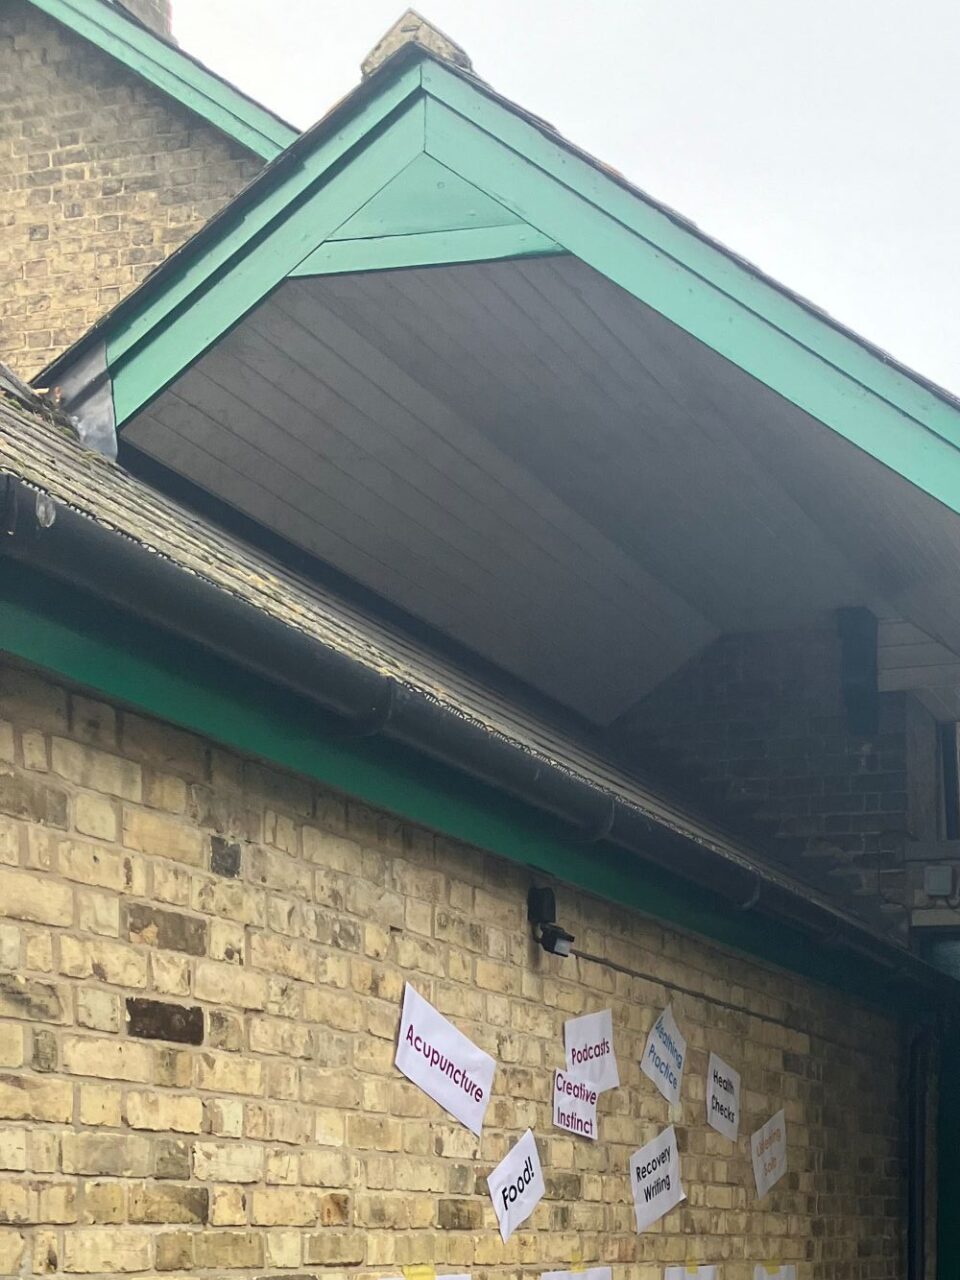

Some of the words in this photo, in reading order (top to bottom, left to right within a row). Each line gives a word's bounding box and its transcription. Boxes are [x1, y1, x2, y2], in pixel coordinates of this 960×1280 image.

[406, 1024, 483, 1102] Acupuncture
[571, 1038, 610, 1065] Podcasts
[648, 1044, 678, 1090] Practice
[713, 1069, 734, 1095] Health
[556, 1073, 597, 1105] Creative
[557, 1107, 593, 1135] Instinct
[711, 1095, 735, 1123] Checks
[636, 1146, 671, 1183] Recovery
[502, 1157, 535, 1210] Food!
[644, 1174, 671, 1203] Writing
